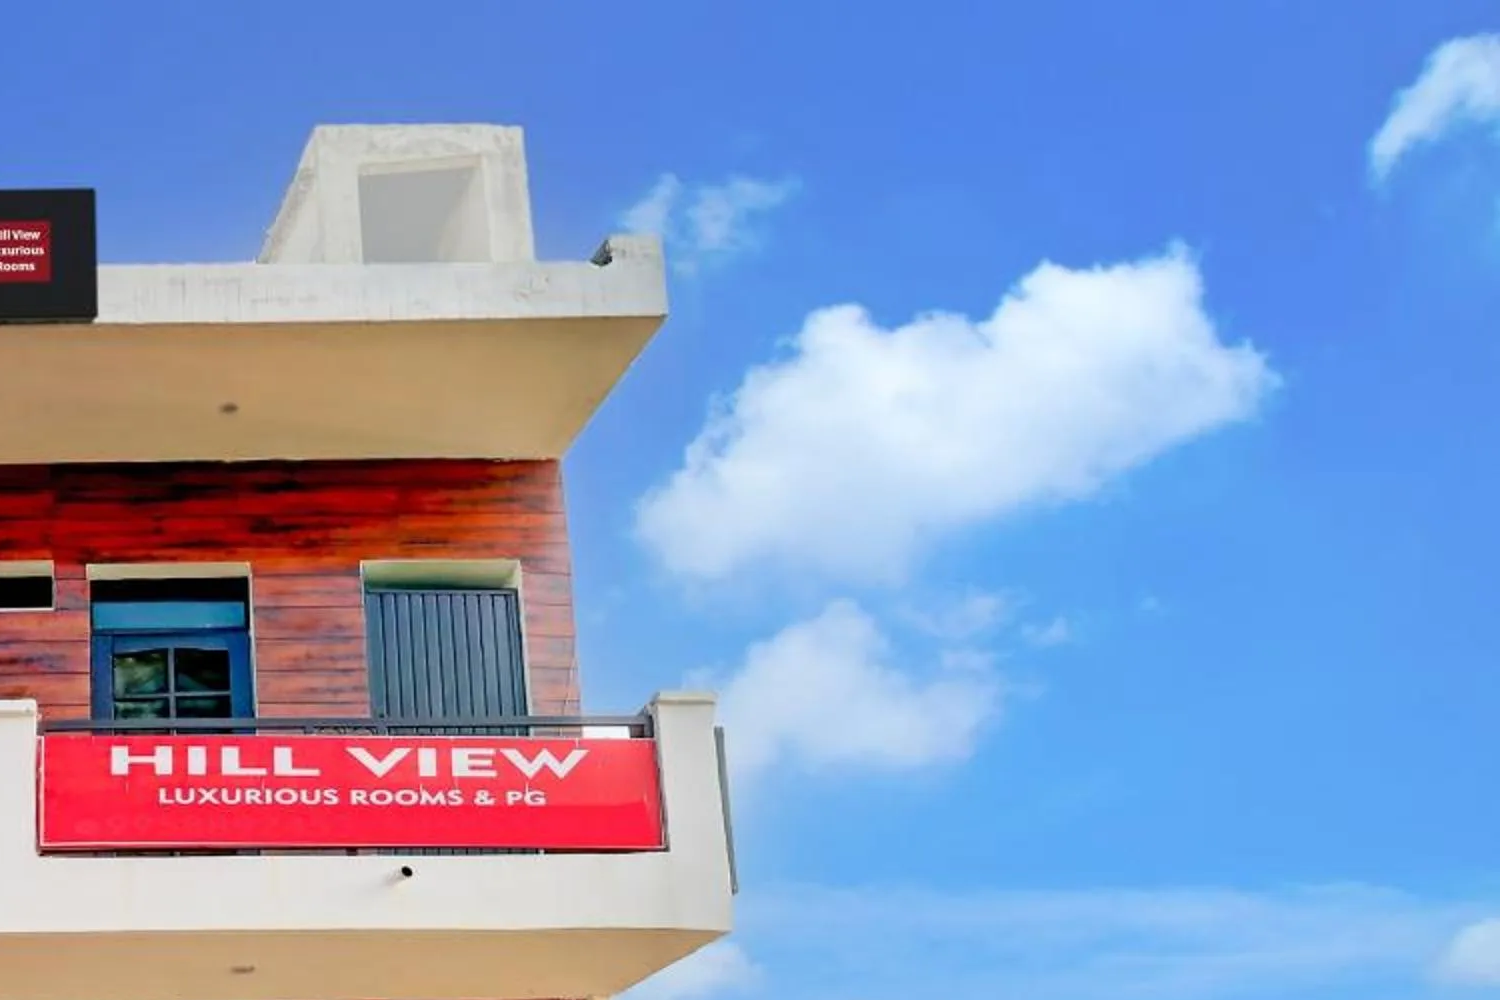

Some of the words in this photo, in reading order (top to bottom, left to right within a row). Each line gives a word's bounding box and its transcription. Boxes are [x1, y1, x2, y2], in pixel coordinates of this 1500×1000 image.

[11, 229, 41, 241] View
[110, 745, 321, 776] HILL
[346, 747, 590, 779] VIEW
[158, 787, 340, 805] LUXURIOUS
[350, 788, 464, 806] ROOMS
[473, 790, 496, 806] &
[506, 790, 547, 806] PG
